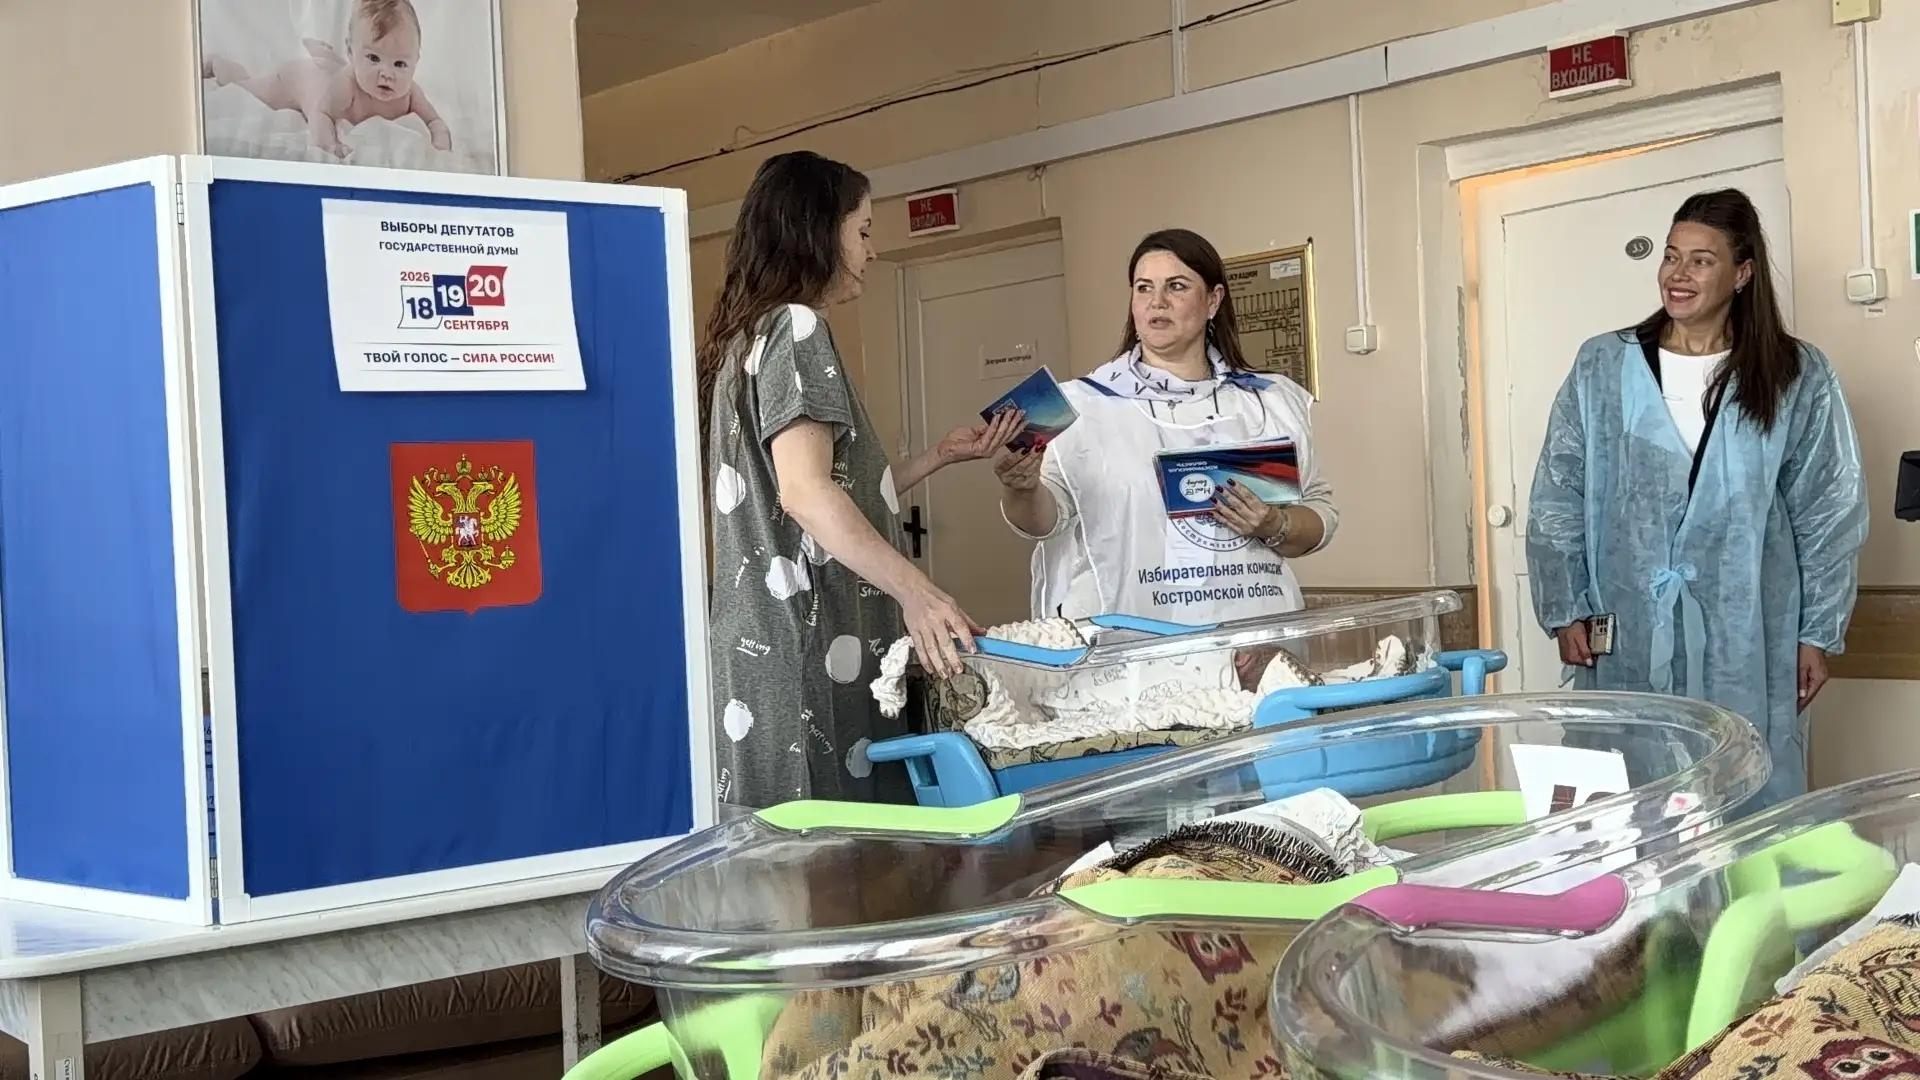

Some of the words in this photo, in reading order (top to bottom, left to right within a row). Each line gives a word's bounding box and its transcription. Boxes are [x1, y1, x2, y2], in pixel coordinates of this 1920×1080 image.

[1572, 45, 1593, 64] НЕ
[1552, 62, 1615, 89] ВХОДИТЬ
[380, 221, 438, 235] ВЫБОРЫ
[440, 224, 515, 238] ДЕПУТАТОВ
[379, 241, 485, 255] ГОСУДАРСТВЕННОЙ
[486, 246, 519, 256] ДУМЫ
[400, 271, 430, 282] 2026
[406, 297, 434, 320] 18
[437, 284, 465, 308] 19
[468, 274, 501, 298] 20
[443, 320, 509, 331] СЕНТЯБРЯ
[363, 350, 401, 364] ТВОЙ
[404, 353, 448, 363] ГОЛОС
[462, 353, 498, 363] СИЛА
[500, 353, 555, 364] РОССИИ!
[1138, 563, 1244, 584] Избирательная
[1152, 583, 1245, 606] Костромской
[741, 637, 771, 655] getting
